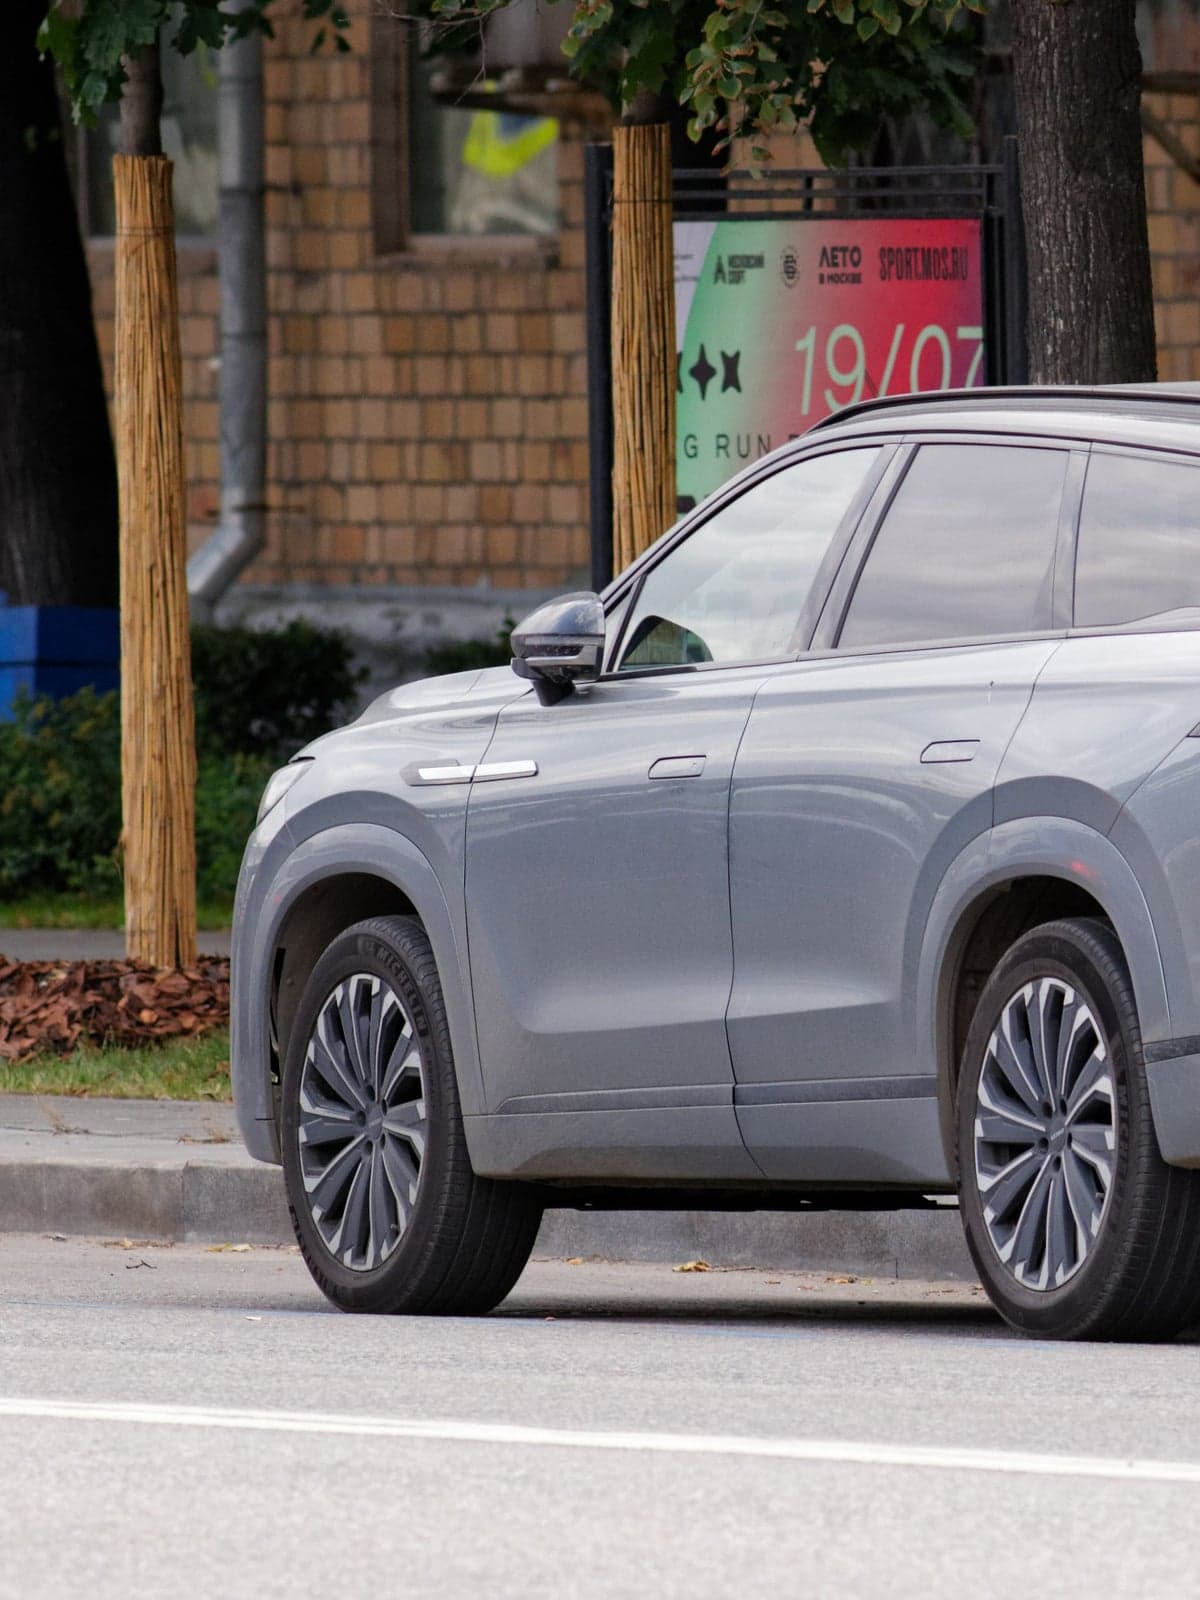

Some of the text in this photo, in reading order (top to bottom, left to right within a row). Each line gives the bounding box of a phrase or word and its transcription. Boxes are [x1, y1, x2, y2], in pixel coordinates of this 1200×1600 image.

[819, 246, 862, 268] ЛЕТО
[796, 324, 983, 416] 19/07
[716, 434, 771, 458] RUN
